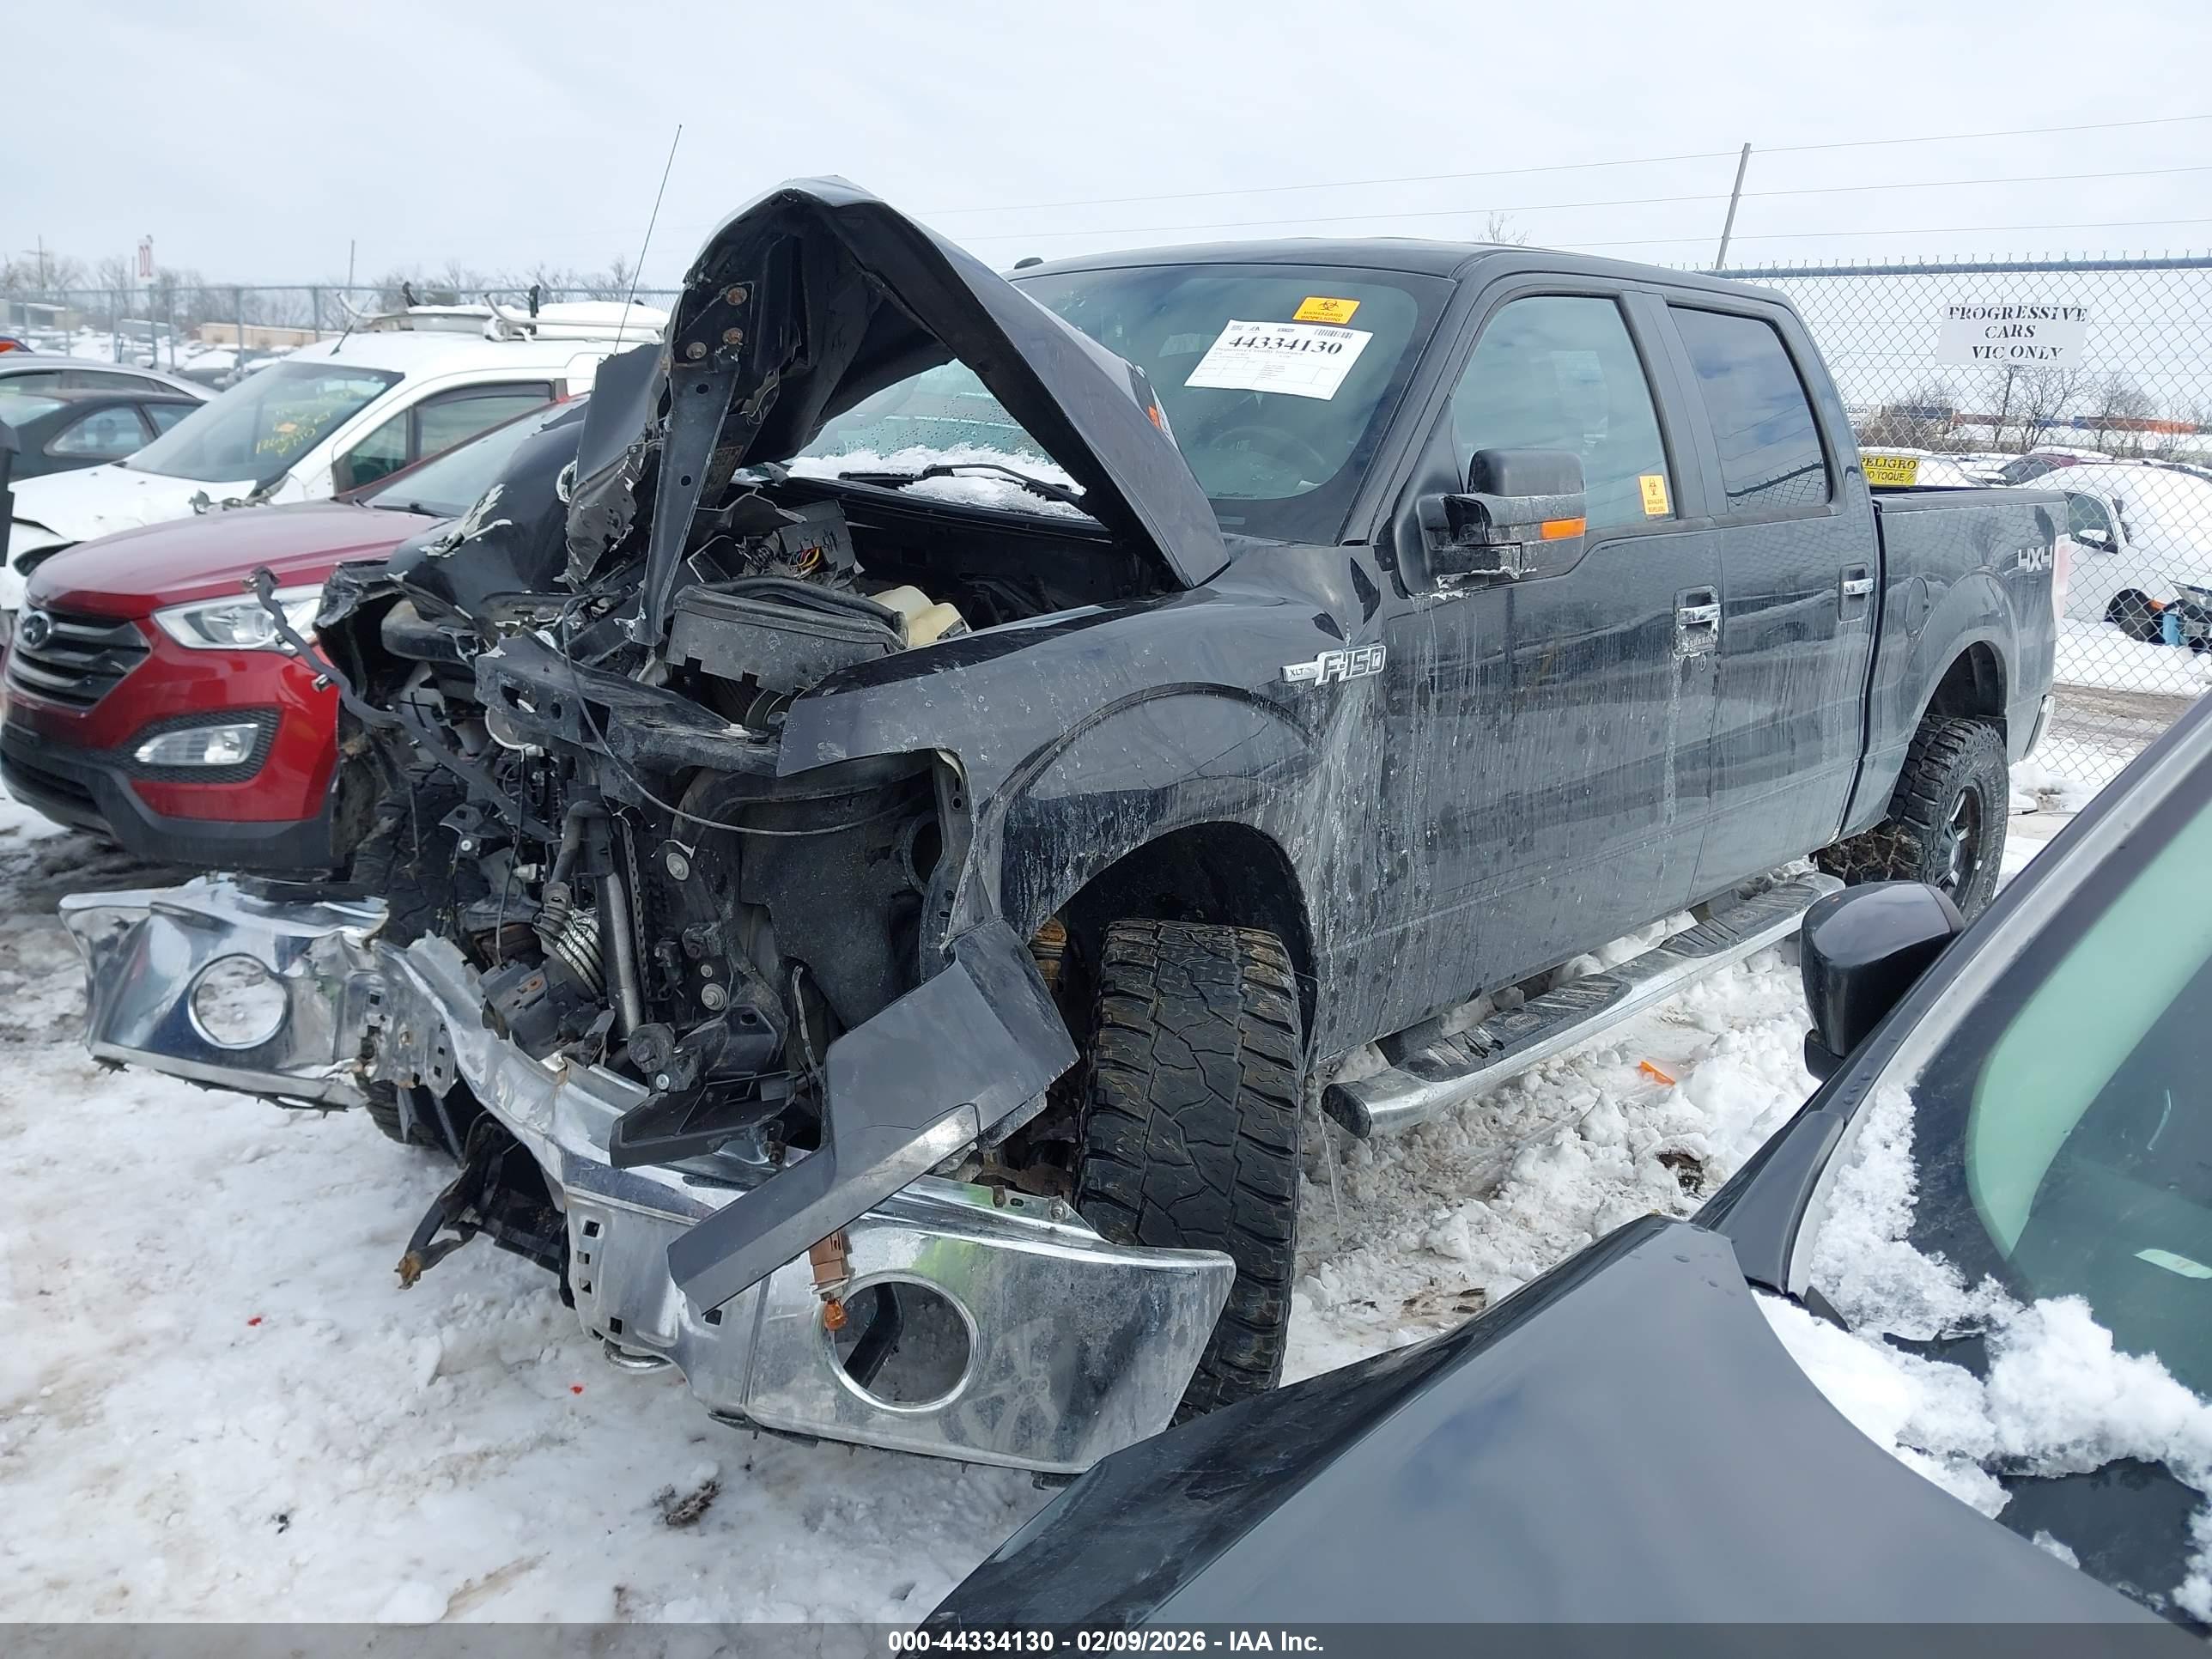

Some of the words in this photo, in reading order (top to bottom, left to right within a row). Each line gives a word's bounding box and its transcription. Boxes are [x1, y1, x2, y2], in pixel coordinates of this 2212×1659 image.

[1948, 305, 2087, 322] PROGRESSIVE
[1984, 324, 2036, 339] CARS
[1229, 336, 1343, 355] 44334130
[1972, 345, 2005, 360] VIC
[2010, 344, 2063, 361] ONLY
[1862, 457, 1917, 471] PELIGRO
[2018, 544, 2053, 573] 4X4
[1290, 667, 1304, 677] XLT
